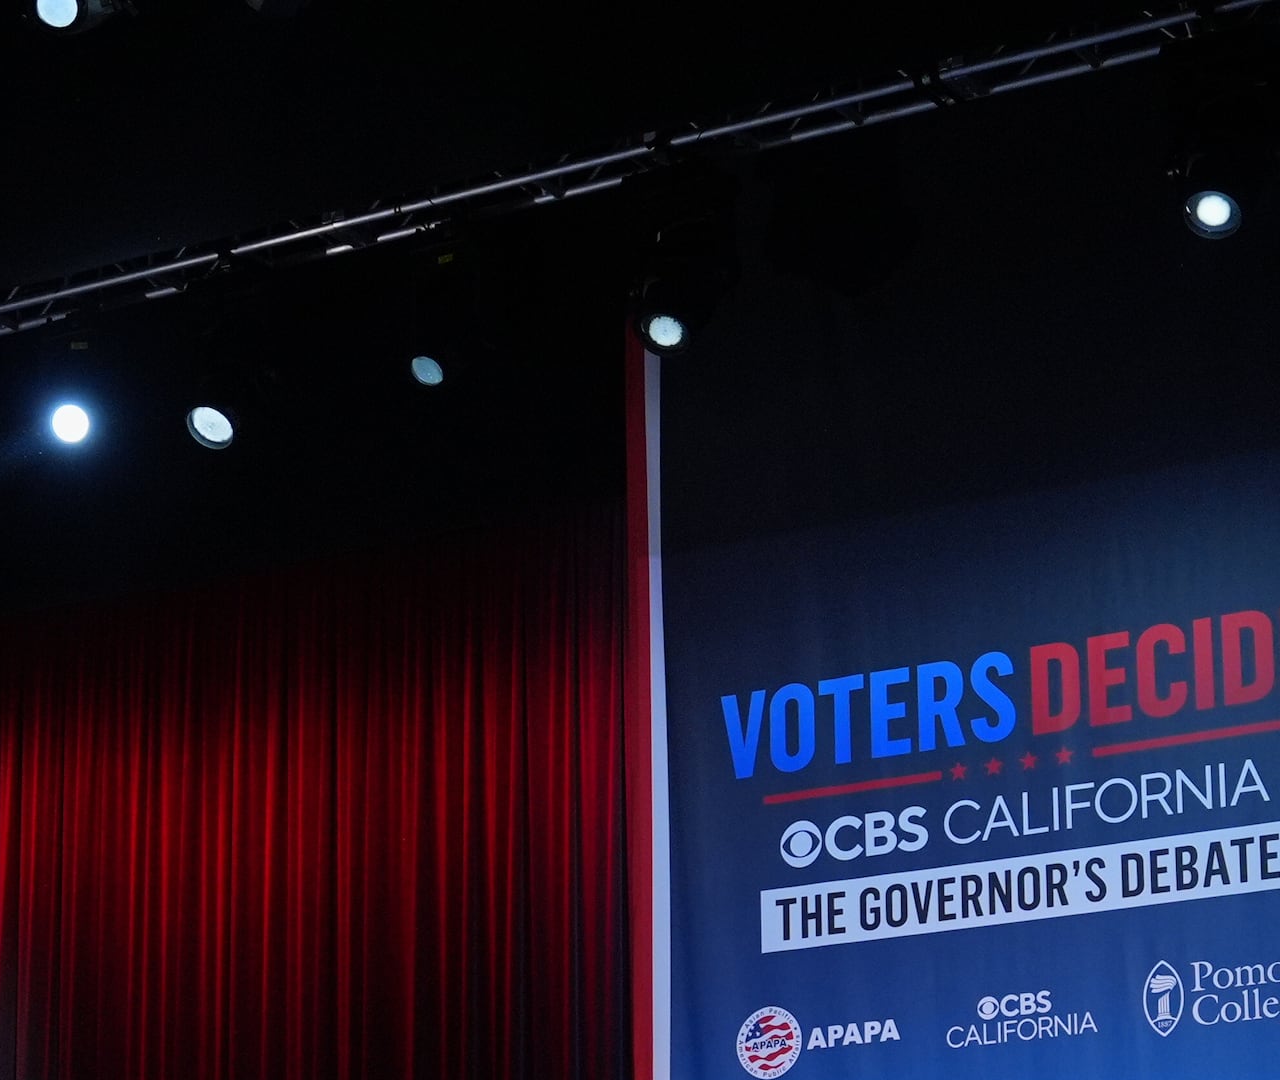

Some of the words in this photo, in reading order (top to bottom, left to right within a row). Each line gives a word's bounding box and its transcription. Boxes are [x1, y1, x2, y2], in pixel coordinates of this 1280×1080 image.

[721, 651, 1017, 779] VOTERS
[825, 806, 929, 861] CBS
[944, 759, 1270, 844] CALIFORNIA
[776, 891, 847, 941] THE
[859, 858, 1107, 931] GOVERNOR'S
[1121, 833, 1280, 898] DEBATE
[744, 1011, 765, 1028] Asian
[768, 1007, 794, 1024] Pacific
[1000, 990, 1052, 1017] CBS
[752, 1039, 787, 1051] APAPA
[807, 1019, 900, 1050] APAPA
[946, 1011, 1098, 1048] CALIFORNIA
[763, 1066, 787, 1078] Public
